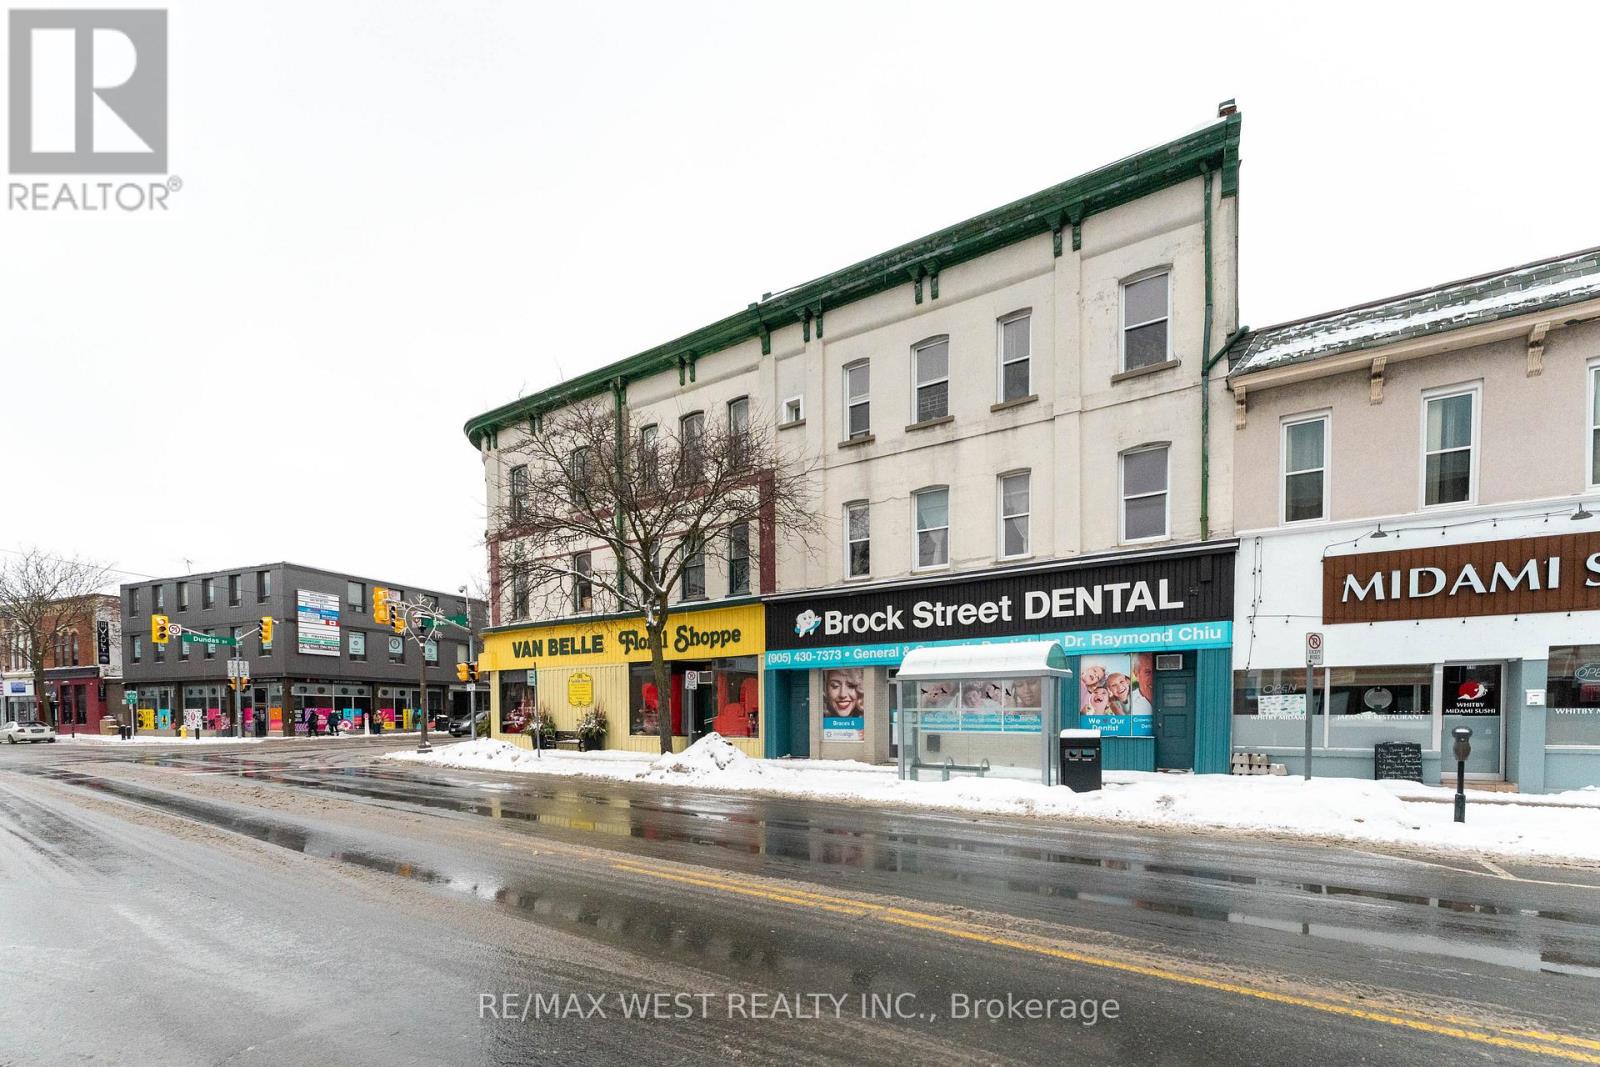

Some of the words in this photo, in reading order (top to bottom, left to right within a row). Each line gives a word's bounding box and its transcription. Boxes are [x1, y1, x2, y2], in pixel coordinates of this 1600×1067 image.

[1341, 556, 1560, 603] MIDAMI
[824, 605, 904, 635] Brock
[912, 595, 1012, 629] Street
[1025, 578, 1184, 620] DENTAL
[193, 636, 220, 644] Dundas
[512, 639, 544, 658] VAN
[549, 634, 604, 656] BELLE
[674, 624, 741, 653] Shoppe
[767, 651, 791, 665] (905)
[794, 649, 841, 663] 430-7373
[853, 646, 899, 660] General
[1064, 635, 1086, 648] Dr.
[1091, 629, 1174, 648] Raymond
[1178, 625, 1222, 641] Chiu
[1088, 717, 1101, 725] We
[1109, 717, 1125, 725] Our
[1092, 724, 1119, 732] Dentist
